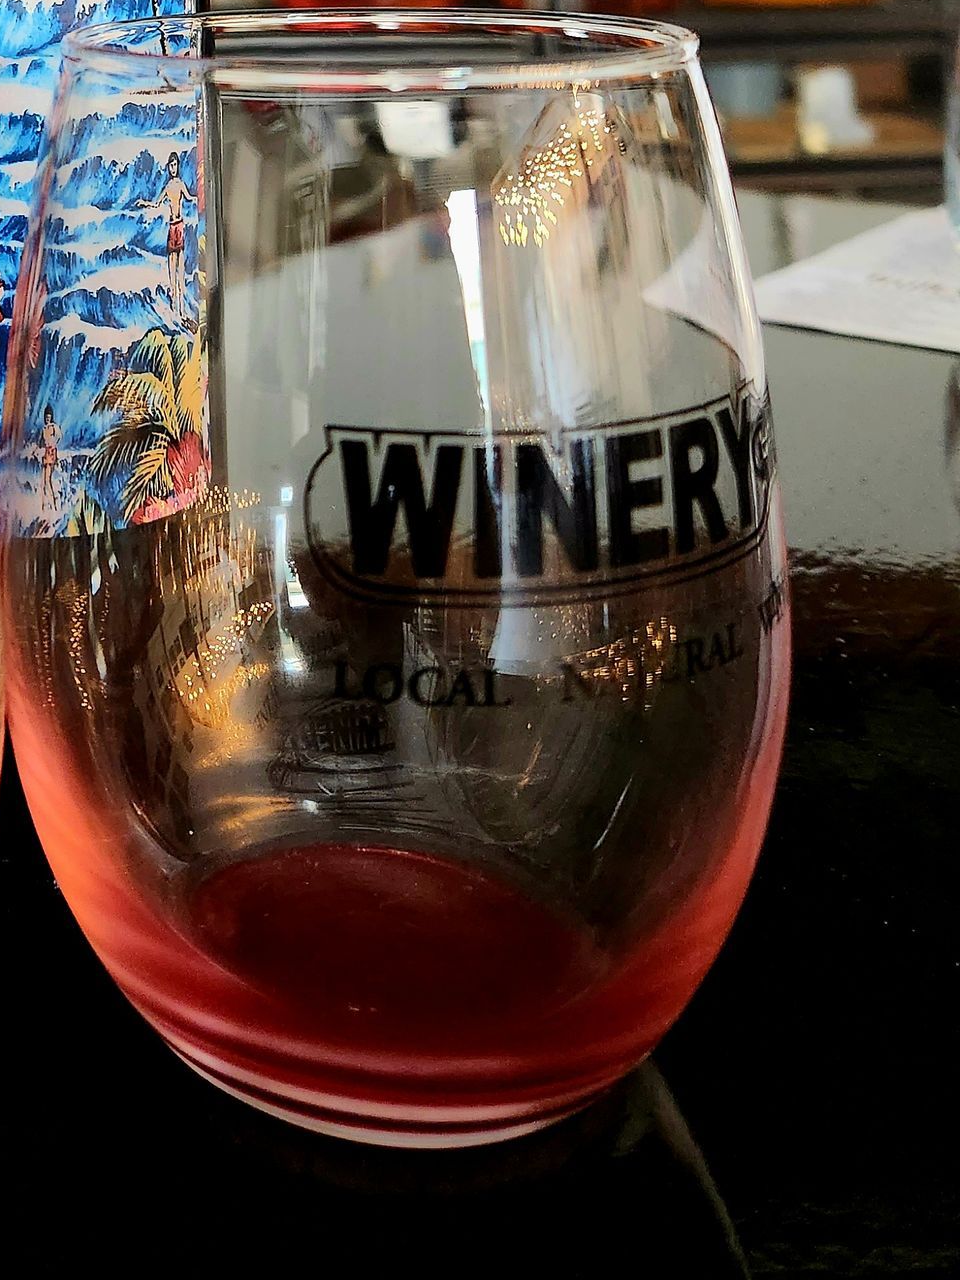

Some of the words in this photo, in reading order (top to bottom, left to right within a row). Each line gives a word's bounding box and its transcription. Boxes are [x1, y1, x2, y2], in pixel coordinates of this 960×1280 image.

[339, 395, 753, 579] WINERY
[331, 659, 512, 709] LOCAL
[560, 622, 744, 703] NURAL
